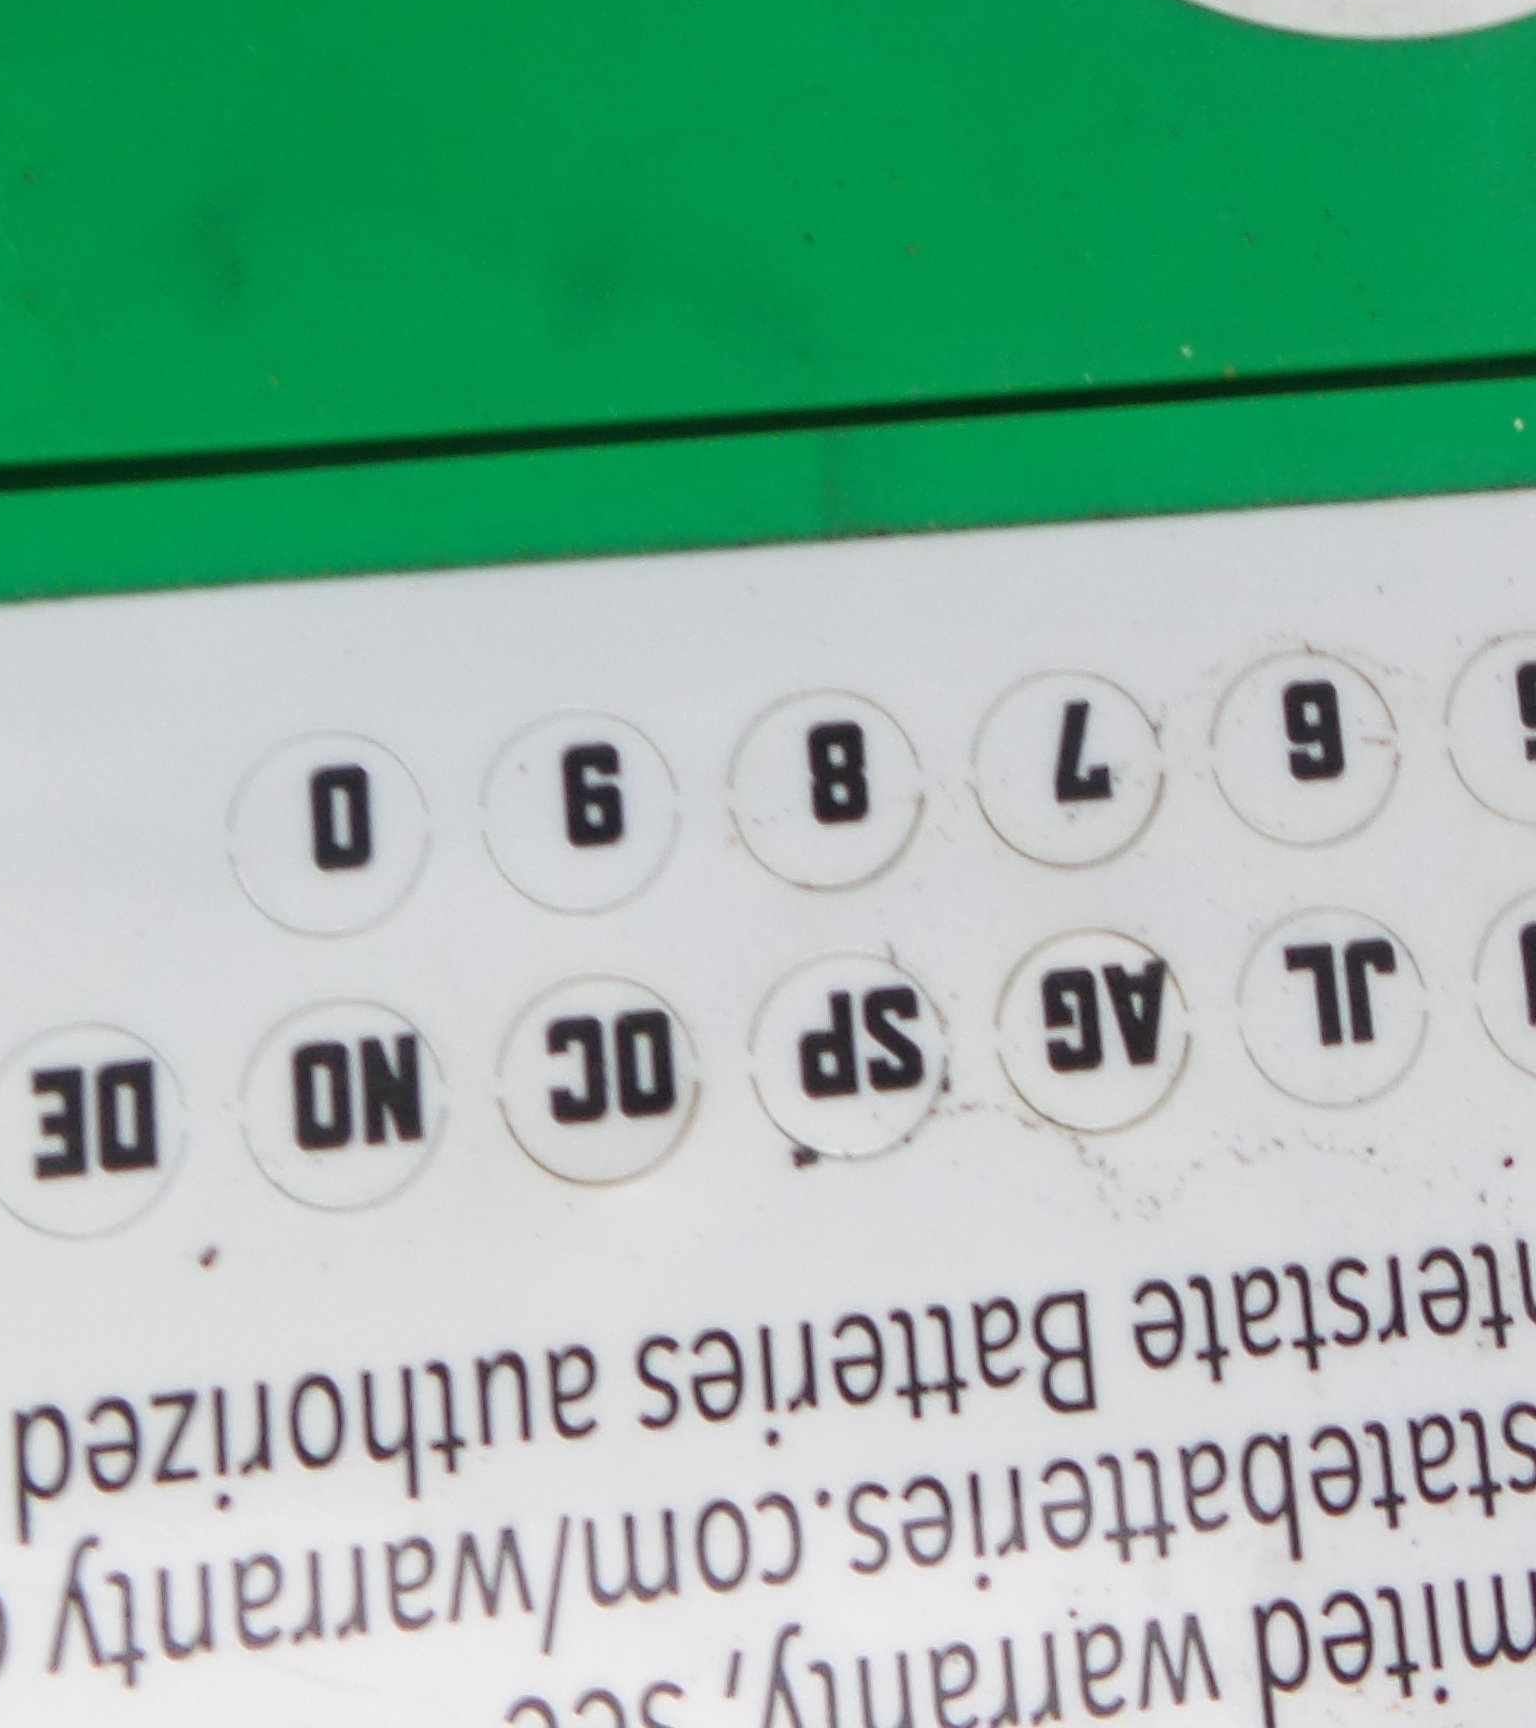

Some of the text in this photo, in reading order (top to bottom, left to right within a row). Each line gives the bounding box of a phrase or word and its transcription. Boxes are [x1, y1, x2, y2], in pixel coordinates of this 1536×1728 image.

[806, 720, 870, 825] 8
[1054, 700, 1113, 805] 7
[1282, 679, 1345, 782] 6
[560, 742, 625, 848] 9
[798, 984, 926, 1100] SP
[1041, 963, 1170, 1067] AG
[1283, 937, 1397, 1047] JL
[31, 1058, 160, 1181] DE
[291, 1032, 425, 1152] NO
[545, 1008, 678, 1125] OC
[635, 1290, 1097, 1430] Batteries
[13, 1344, 597, 1544] authorized
[727, 1614, 1220, 1728] warranty,
